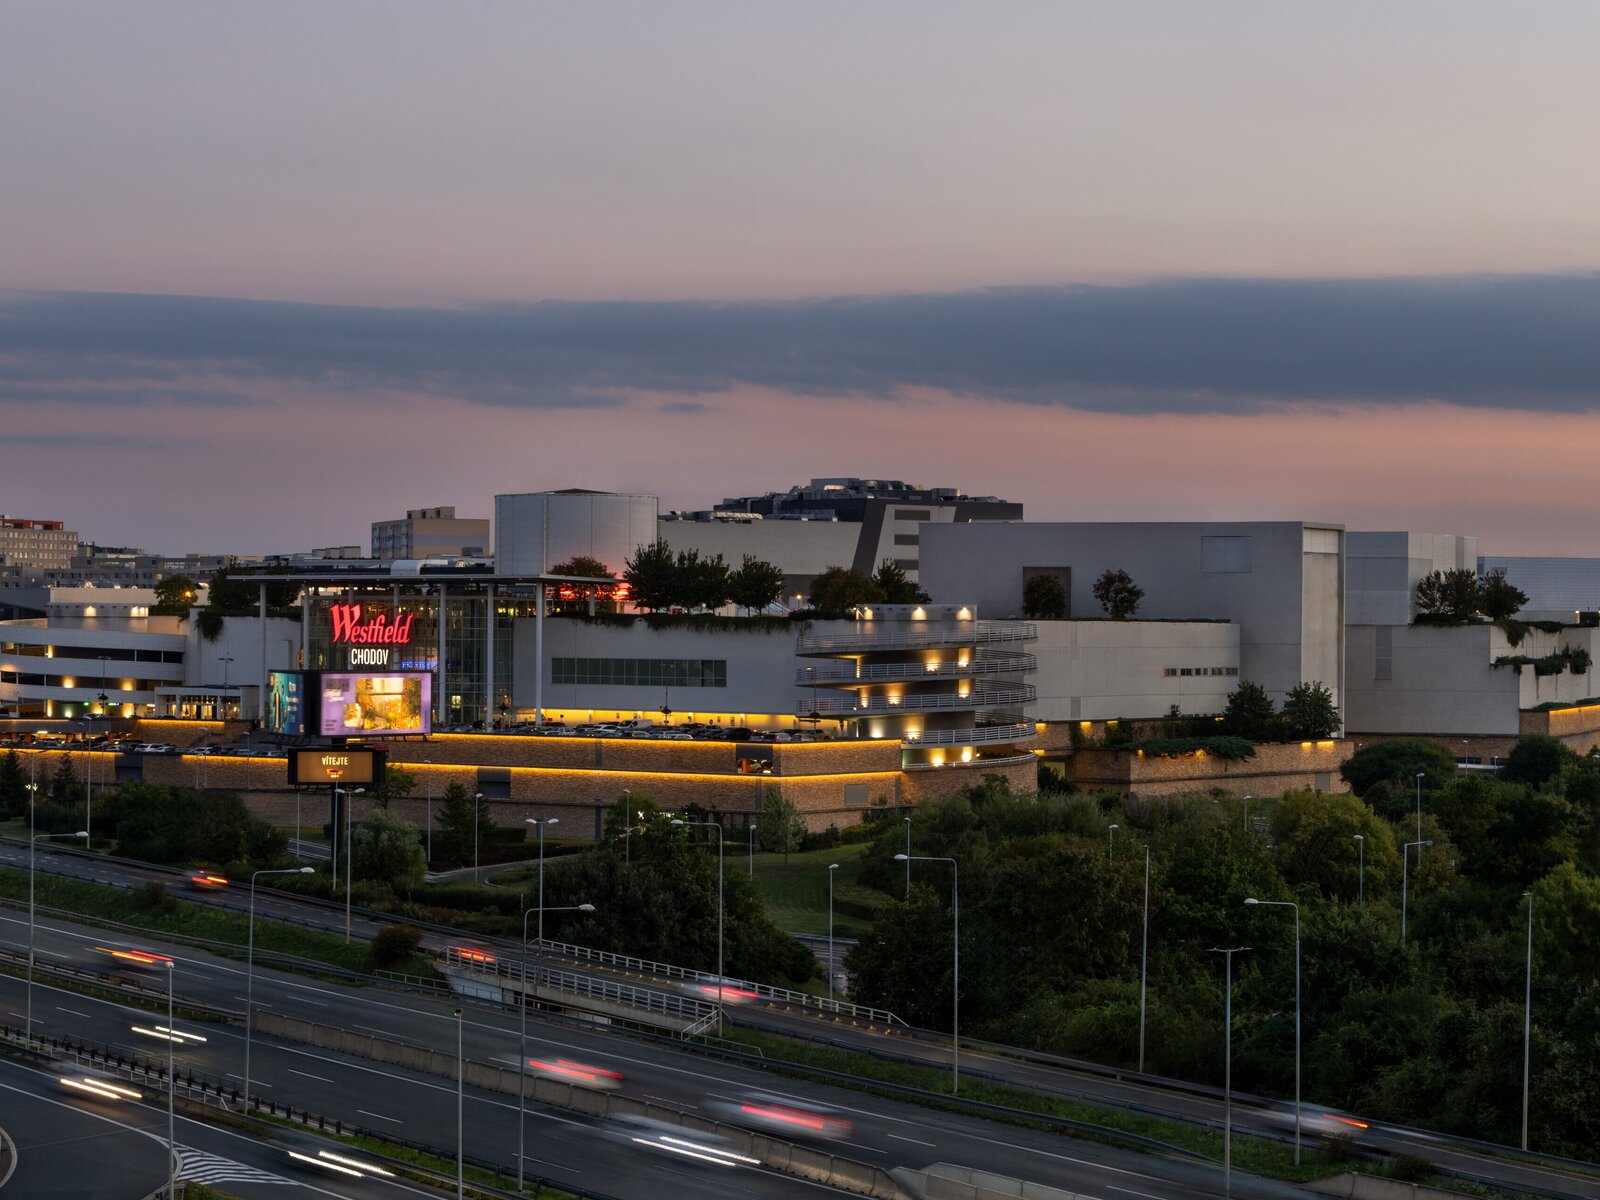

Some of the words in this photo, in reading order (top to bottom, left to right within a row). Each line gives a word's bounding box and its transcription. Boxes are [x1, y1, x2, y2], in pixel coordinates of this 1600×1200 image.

[328, 604, 413, 643] Westfield
[351, 648, 389, 665] CHODOV
[321, 755, 349, 766] VÍTEJTE
